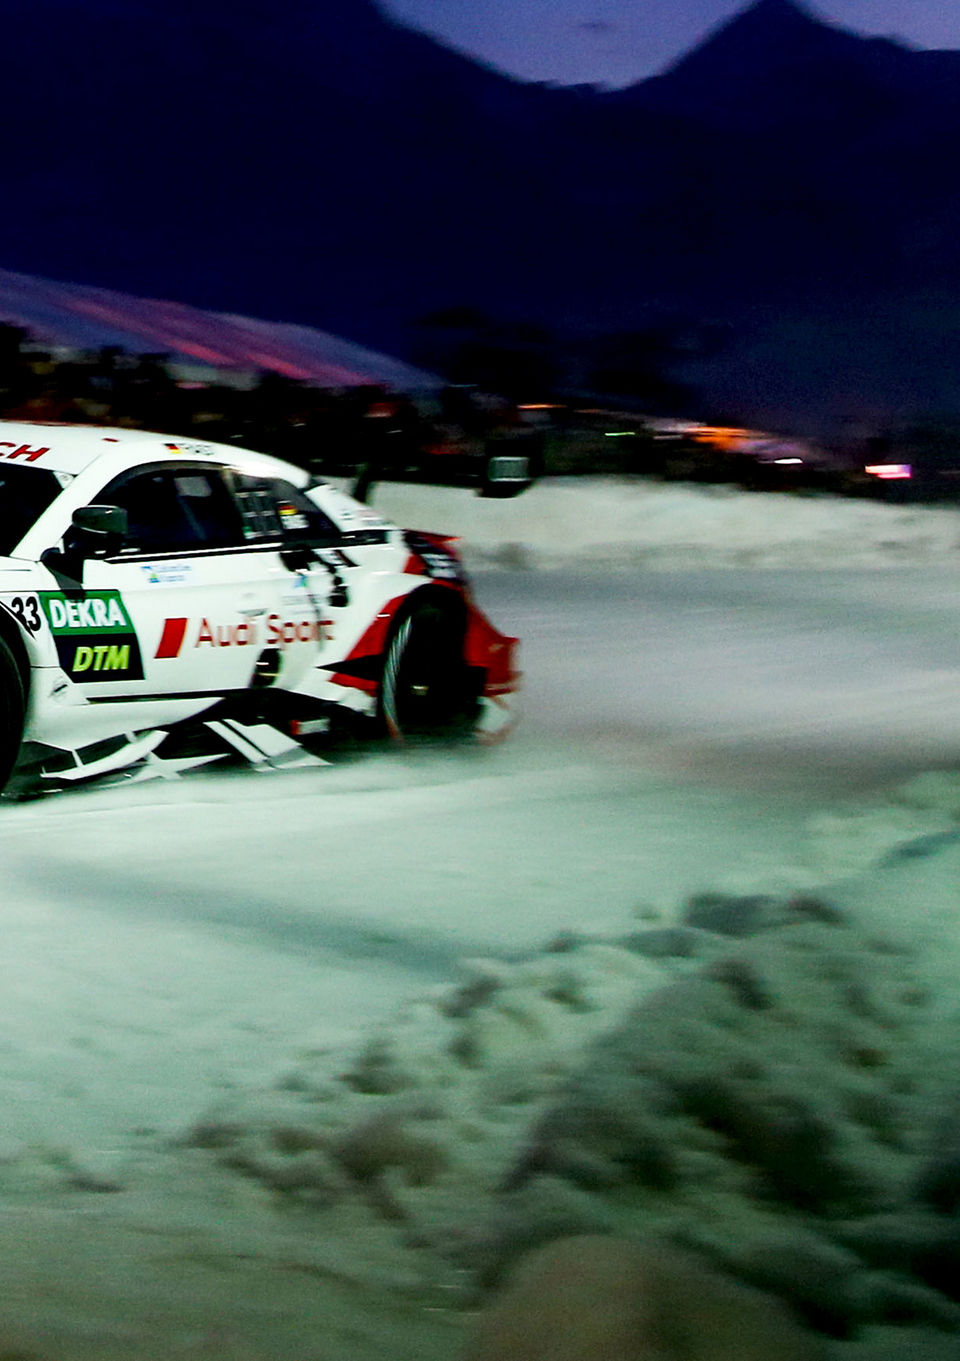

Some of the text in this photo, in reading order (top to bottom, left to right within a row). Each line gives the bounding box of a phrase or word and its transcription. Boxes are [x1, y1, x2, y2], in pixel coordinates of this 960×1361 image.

[11, 596, 41, 632] 33
[48, 598, 127, 628] DEKRA
[194, 615, 257, 648] Audi
[72, 645, 131, 672] DTM
